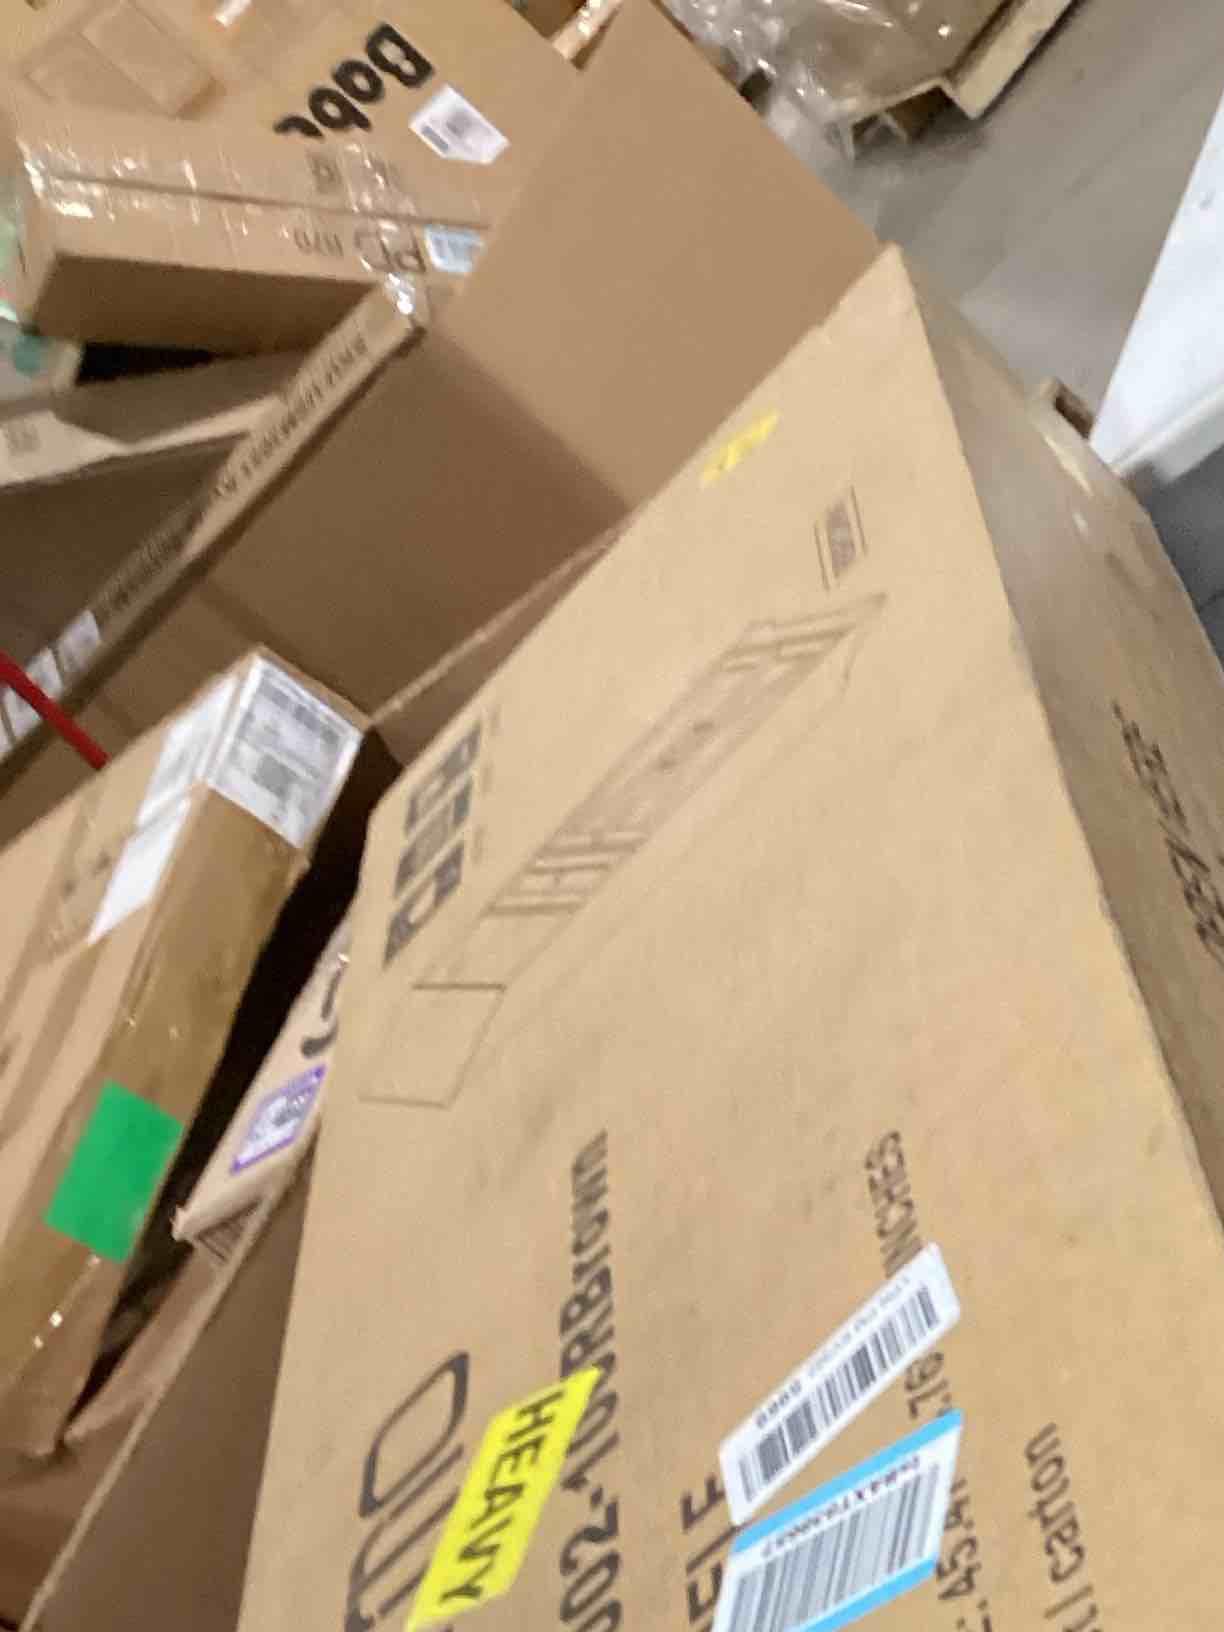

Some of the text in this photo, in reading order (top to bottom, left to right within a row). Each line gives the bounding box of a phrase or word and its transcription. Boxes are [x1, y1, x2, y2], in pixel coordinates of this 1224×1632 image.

[863, 1130, 925, 1280] INCHES
[437, 1389, 565, 1606] HEAVY
[1023, 1421, 1086, 1584] carton
